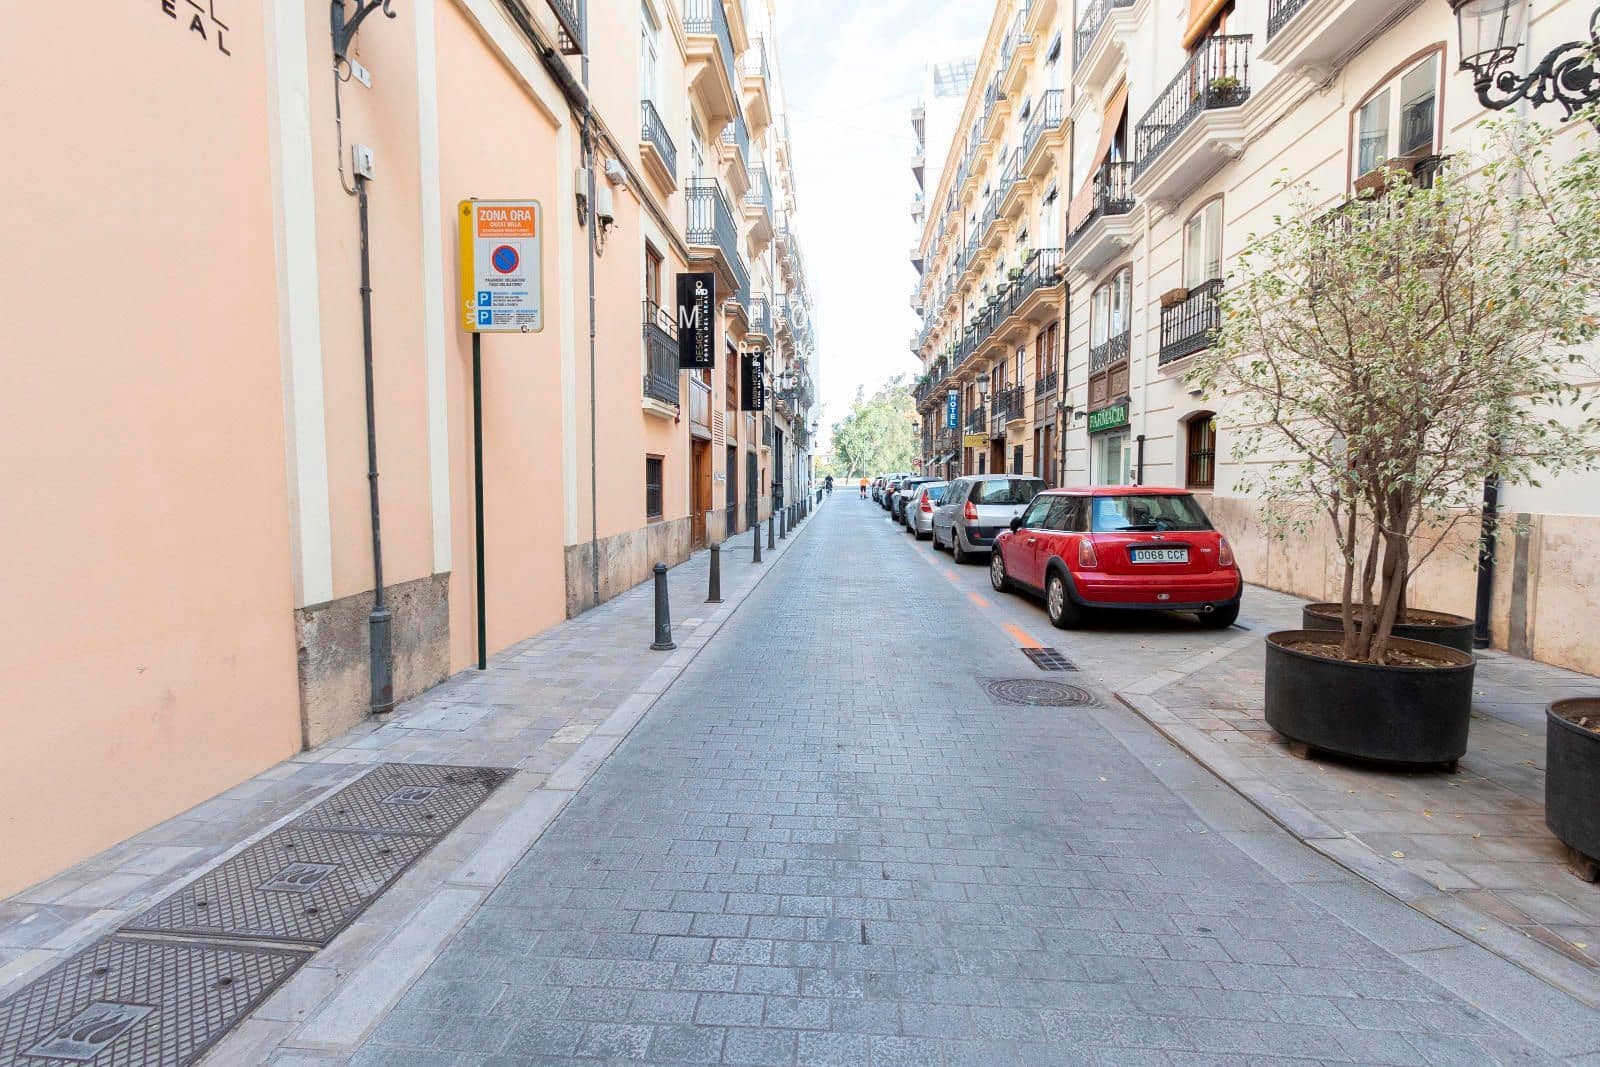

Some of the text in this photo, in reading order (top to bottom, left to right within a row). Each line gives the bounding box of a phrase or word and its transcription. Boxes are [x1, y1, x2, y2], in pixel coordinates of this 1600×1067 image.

[480, 209, 531, 221] ZONA ORA
[695, 329, 703, 362] DESIGN
[1089, 405, 1125, 429] FARMACIA
[1167, 550, 1186, 560] CCF
